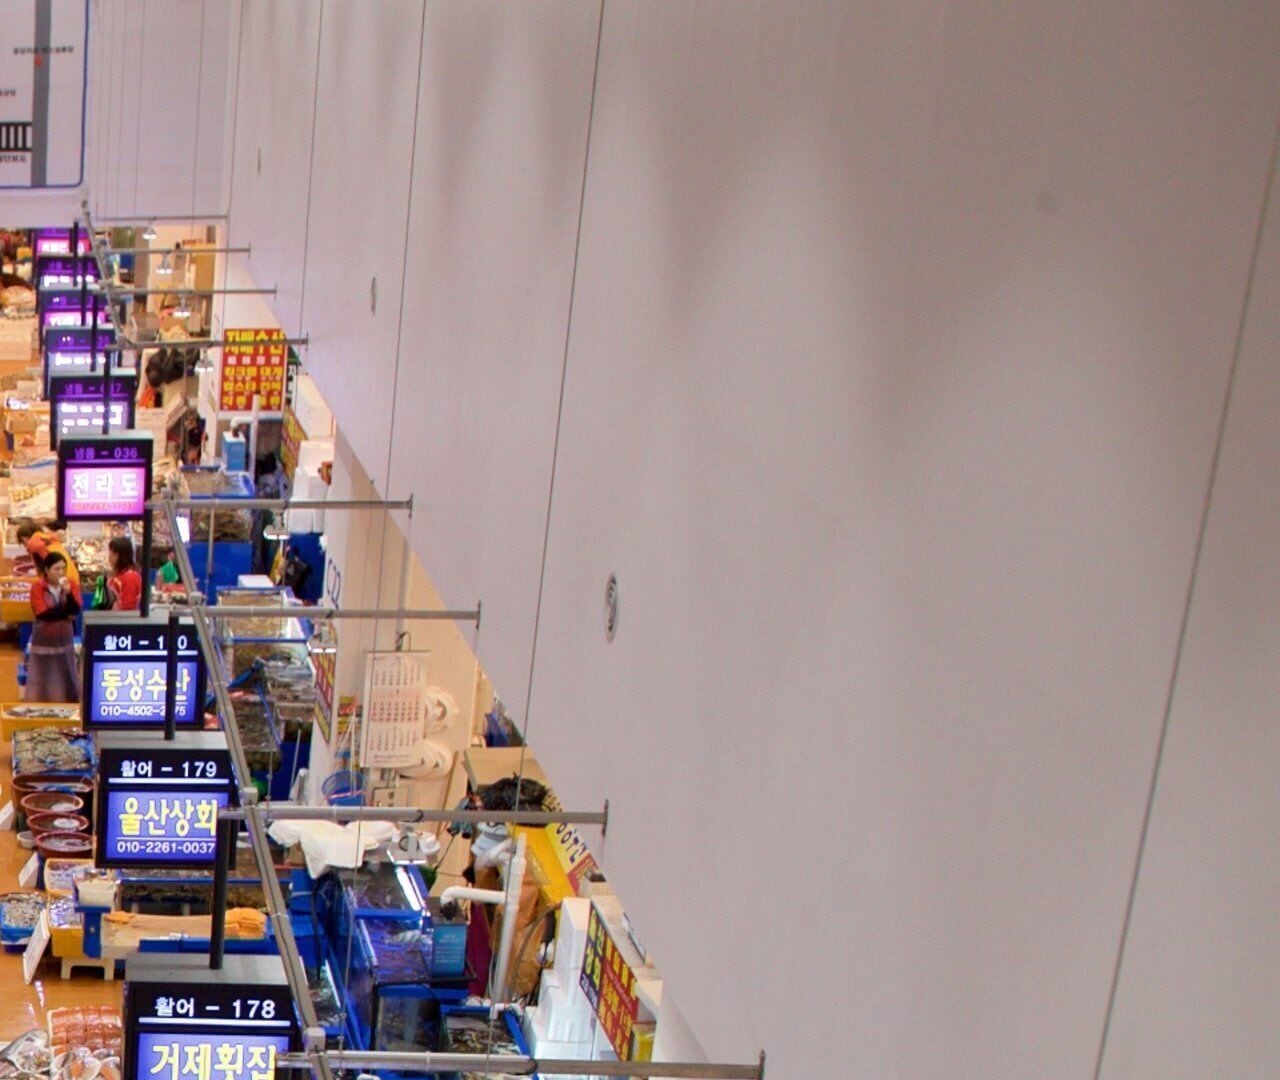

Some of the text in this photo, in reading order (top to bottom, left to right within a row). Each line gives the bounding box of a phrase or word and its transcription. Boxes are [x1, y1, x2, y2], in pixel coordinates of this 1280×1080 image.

[114, 447, 138, 459] 036
[71, 471, 138, 500] 전라도
[104, 634, 132, 650] 활어
[157, 635, 188, 649] 10
[100, 705, 187, 717] 010-4502-275
[121, 761, 152, 777] 활어
[182, 761, 217, 776] 179
[119, 797, 217, 837] 울산상회
[117, 842, 216, 854] 010-2261-0037
[155, 997, 196, 1019] 활어
[232, 999, 276, 1019] 178
